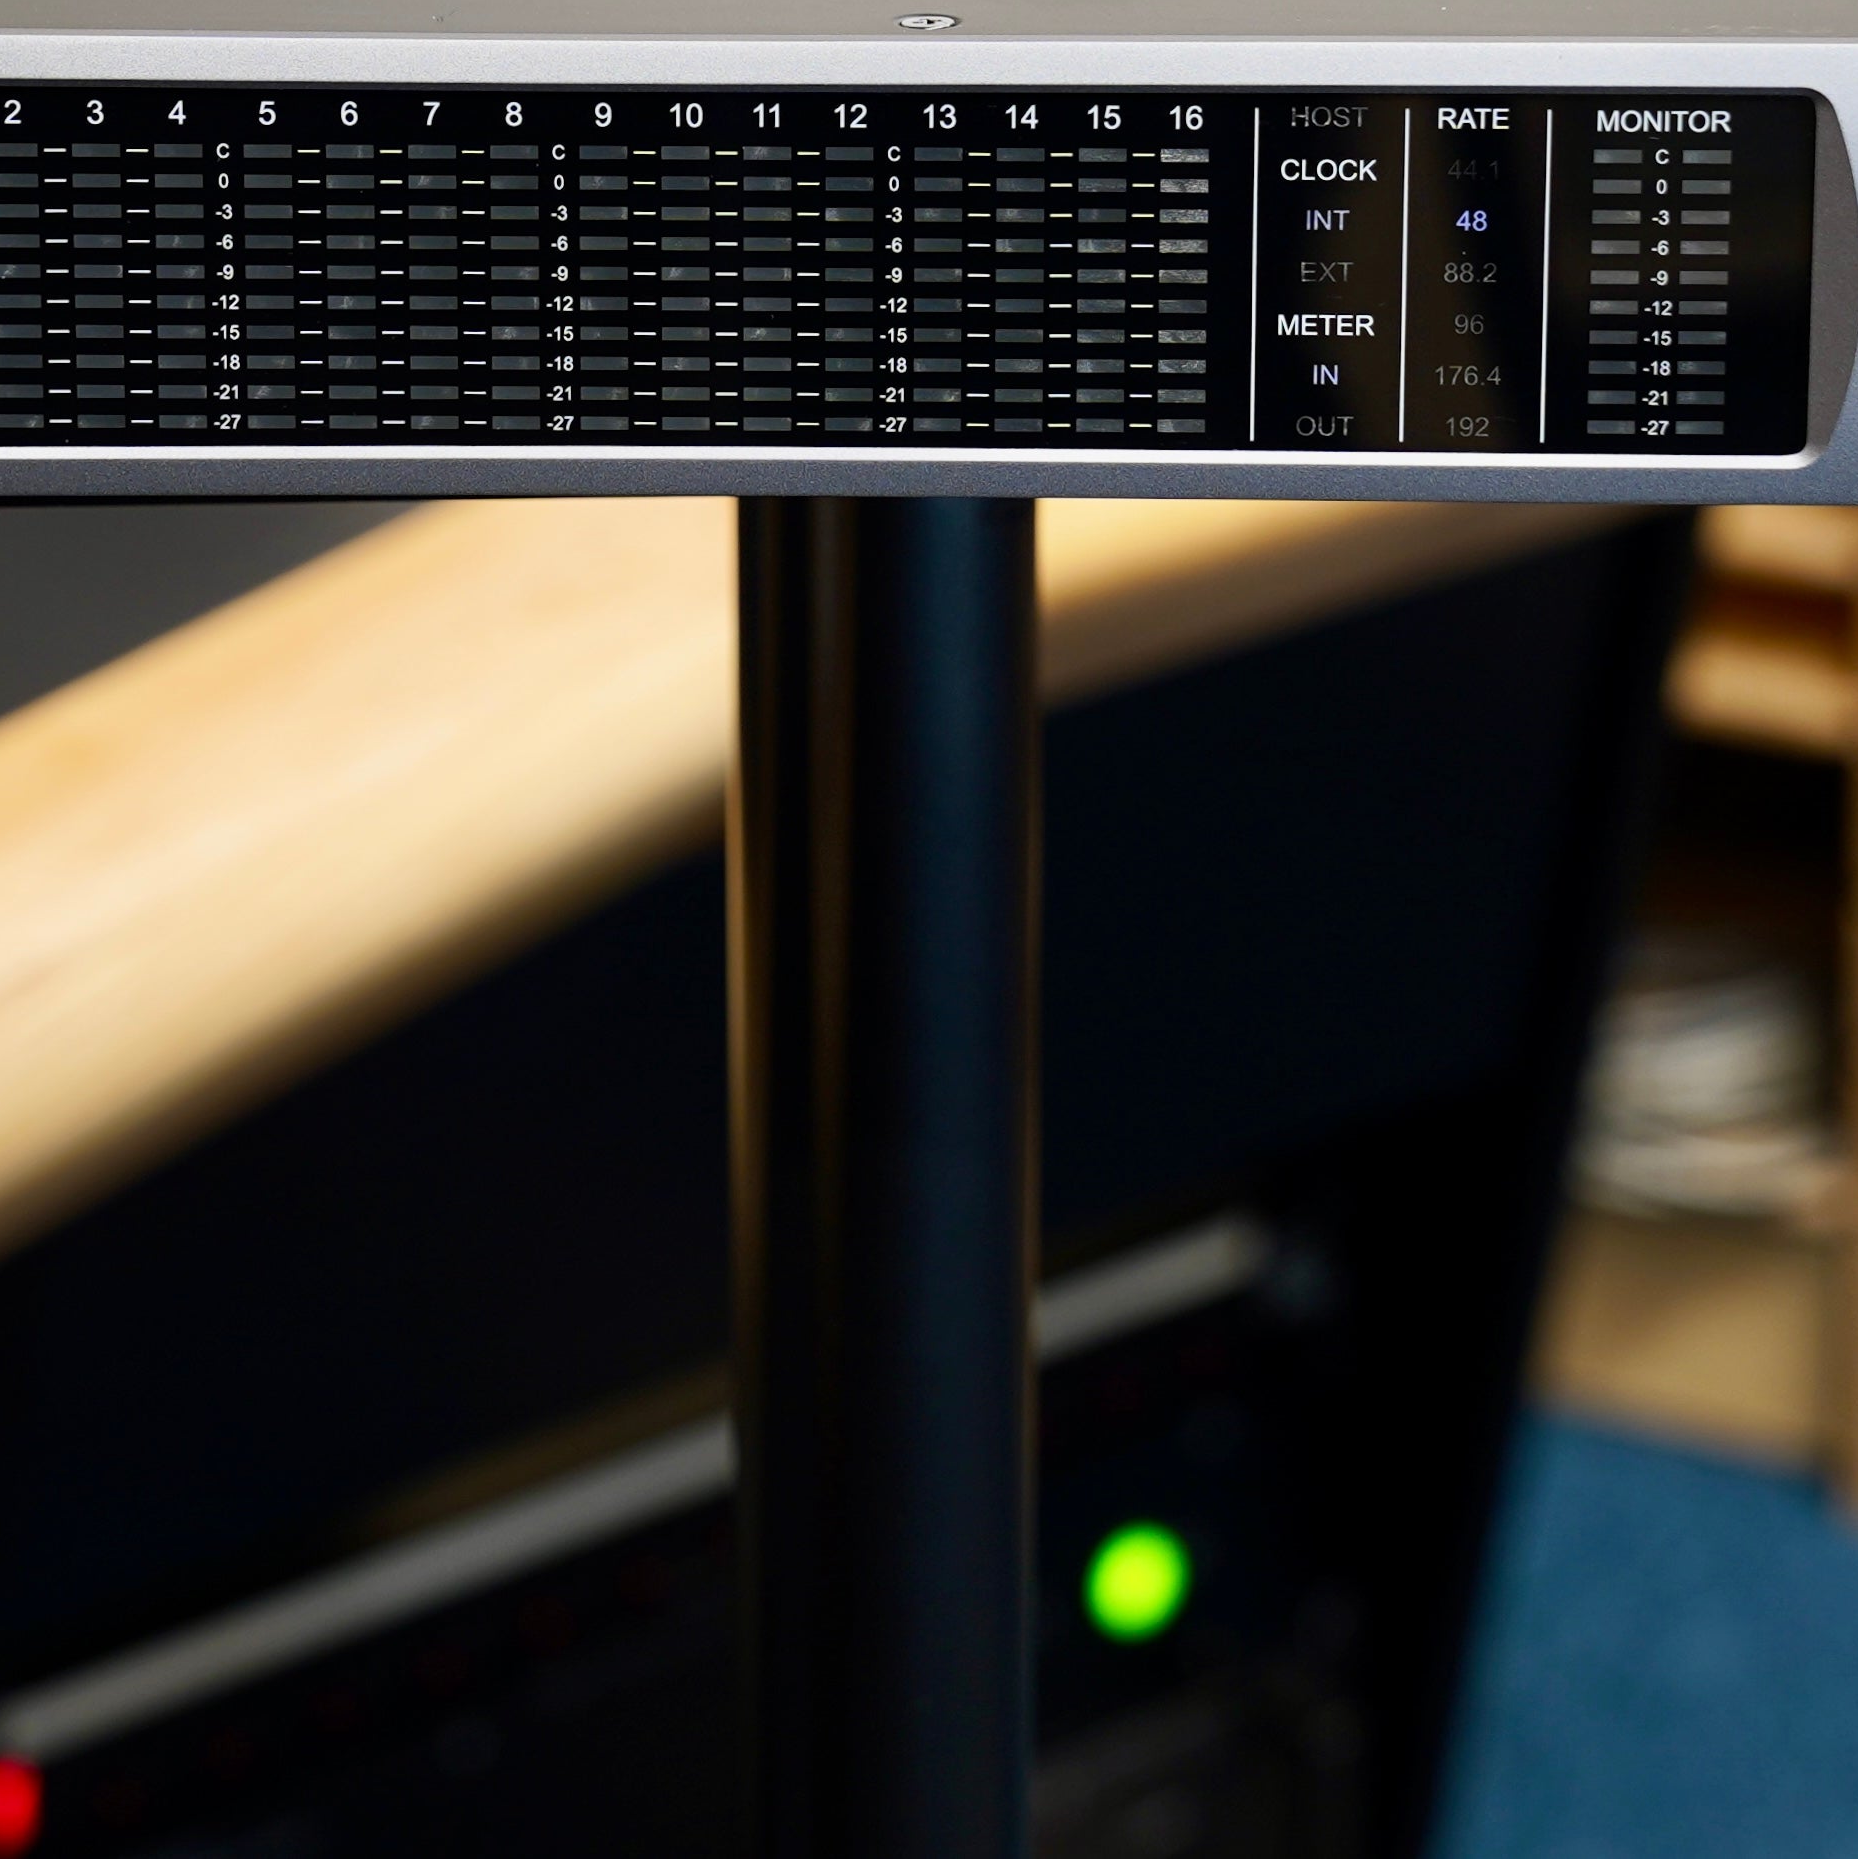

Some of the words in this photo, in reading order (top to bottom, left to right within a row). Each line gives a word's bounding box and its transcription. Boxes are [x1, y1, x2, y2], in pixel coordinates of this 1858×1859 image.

[3, 99, 22, 125] 2
[86, 99, 105, 125] 3
[167, 100, 187, 125] 4
[258, 100, 277, 126] 5
[340, 100, 359, 127] 6
[422, 101, 441, 126] 7
[505, 101, 523, 127] 8
[594, 102, 613, 128] 9
[669, 102, 704, 129] 10
[752, 102, 780, 128] 11
[834, 103, 868, 129] 12
[923, 103, 957, 130] 13
[1005, 104, 1039, 130] 14
[1087, 104, 1122, 130] 15
[1169, 105, 1204, 131] 16
[1291, 106, 1368, 128] HOST
[1437, 107, 1510, 130] RATE
[1596, 109, 1732, 133] MONITOR
[216, 142, 230, 159] C
[551, 143, 566, 161] C
[887, 145, 901, 162] C
[1655, 148, 1670, 165] C
[1280, 158, 1377, 182] CLOCK
[1447, 159, 1498, 180] 44.1
[218, 172, 230, 189] 0
[553, 174, 565, 191] 0
[888, 175, 900, 192] 0
[1656, 178, 1668, 195] 0
[215, 203, 233, 220] -3
[550, 204, 568, 222] -3
[885, 206, 903, 223] -3
[1306, 209, 1351, 231] INT
[1651, 209, 1670, 226] -3
[1455, 210, 1488, 232] 48
[215, 233, 234, 250] -6
[550, 235, 569, 252] -6
[885, 236, 903, 254] -6
[1651, 239, 1670, 256] -6
[216, 263, 235, 281] -9
[550, 265, 569, 282] -9
[884, 267, 903, 284] -9
[1300, 261, 1354, 283] EXT
[1443, 262, 1496, 283] 88.2
[1650, 270, 1669, 286] -9
[211, 293, 240, 311] -12
[546, 295, 574, 312] -12
[879, 297, 908, 314] -12
[1644, 300, 1673, 316] -12
[212, 324, 240, 341] -15
[1277, 313, 1375, 337] METER
[1454, 314, 1484, 335] 96
[546, 325, 574, 342] -15
[879, 327, 908, 344] -15
[1643, 330, 1672, 347] -15
[212, 354, 241, 371] -18
[546, 355, 574, 372] -18
[879, 356, 908, 374] -18
[1642, 360, 1671, 377] -18
[1313, 364, 1339, 386] IN
[1435, 365, 1502, 386] 176.4
[213, 383, 239, 400] -21
[546, 385, 572, 402] -21
[879, 386, 905, 403] -21
[1641, 390, 1668, 406] -21
[213, 413, 242, 430] -27
[546, 415, 575, 431] -27
[879, 416, 907, 433] -27
[1296, 415, 1354, 437] OUT
[1446, 416, 1490, 437] 192
[1640, 419, 1670, 436] -27
